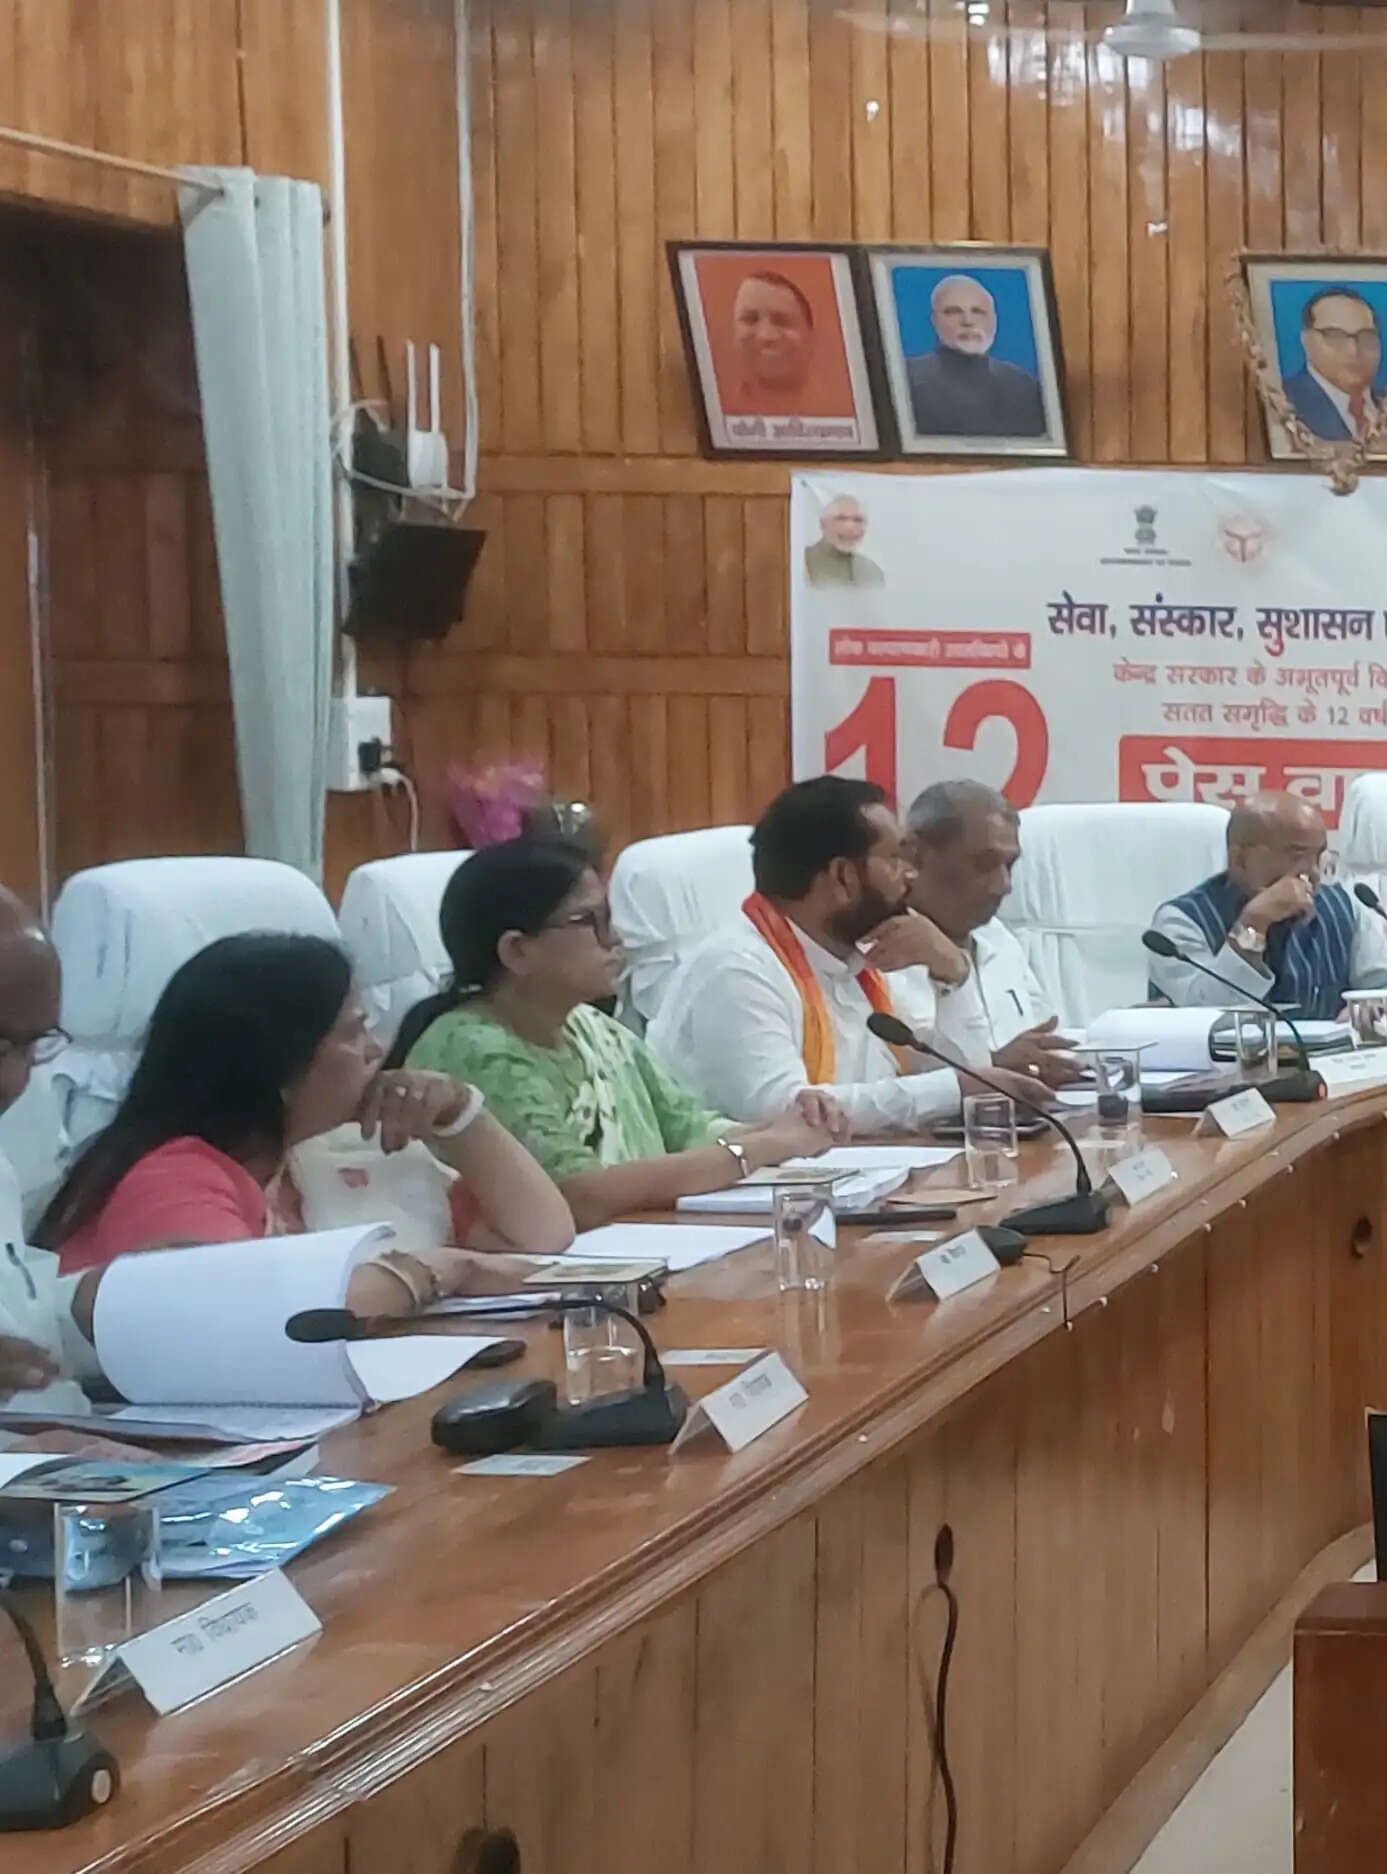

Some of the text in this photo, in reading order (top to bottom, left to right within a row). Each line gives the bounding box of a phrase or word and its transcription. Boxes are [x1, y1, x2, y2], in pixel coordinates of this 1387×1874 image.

[1047, 590, 1117, 639] सेवा,
[1129, 592, 1243, 642] संस्कार,
[1256, 607, 1375, 657] सुशासन
[1165, 665, 1237, 686] सरकार
[1246, 657, 1266, 686] के
[1161, 702, 1213, 723] सतत
[1297, 698, 1316, 725] के
[1327, 705, 1350, 726] 12
[825, 676, 1049, 816] 12
